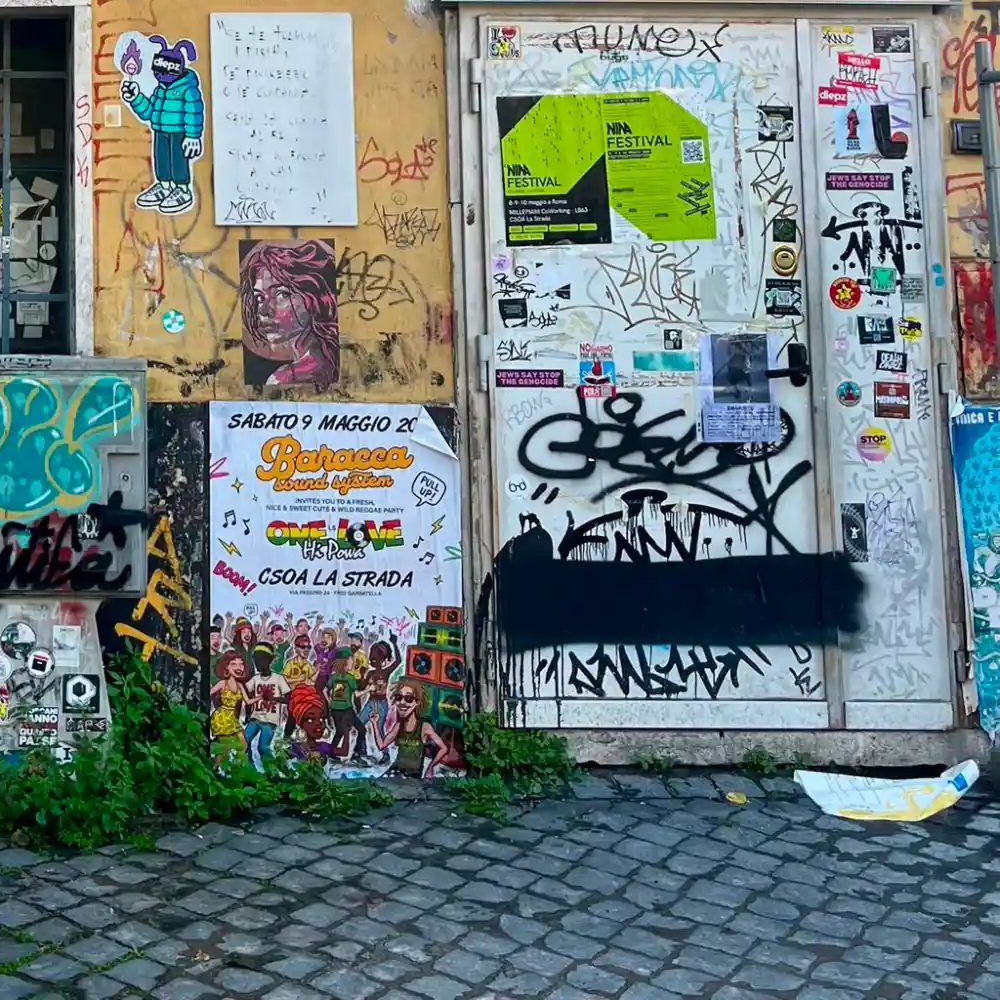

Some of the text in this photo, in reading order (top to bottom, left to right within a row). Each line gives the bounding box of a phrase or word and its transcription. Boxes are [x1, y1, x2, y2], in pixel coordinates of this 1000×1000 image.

[154, 58, 181, 72] diepz
[819, 90, 846, 103] diepz
[607, 134, 672, 148] FESTIVAL
[507, 177, 561, 188] FESTIVAL
[228, 413, 297, 429] SABATO
[302, 414, 312, 430] 9
[318, 415, 391, 432] MAGGIO
[860, 435, 887, 445] STOP
[256, 434, 414, 481] Baracca
[273, 471, 393, 495] sound system
[266, 519, 404, 551] ONE LOVE
[213, 560, 257, 596] BOOM!
[259, 568, 413, 587] CSOA LA STRADA
[255, 702, 276, 714] LOVE
